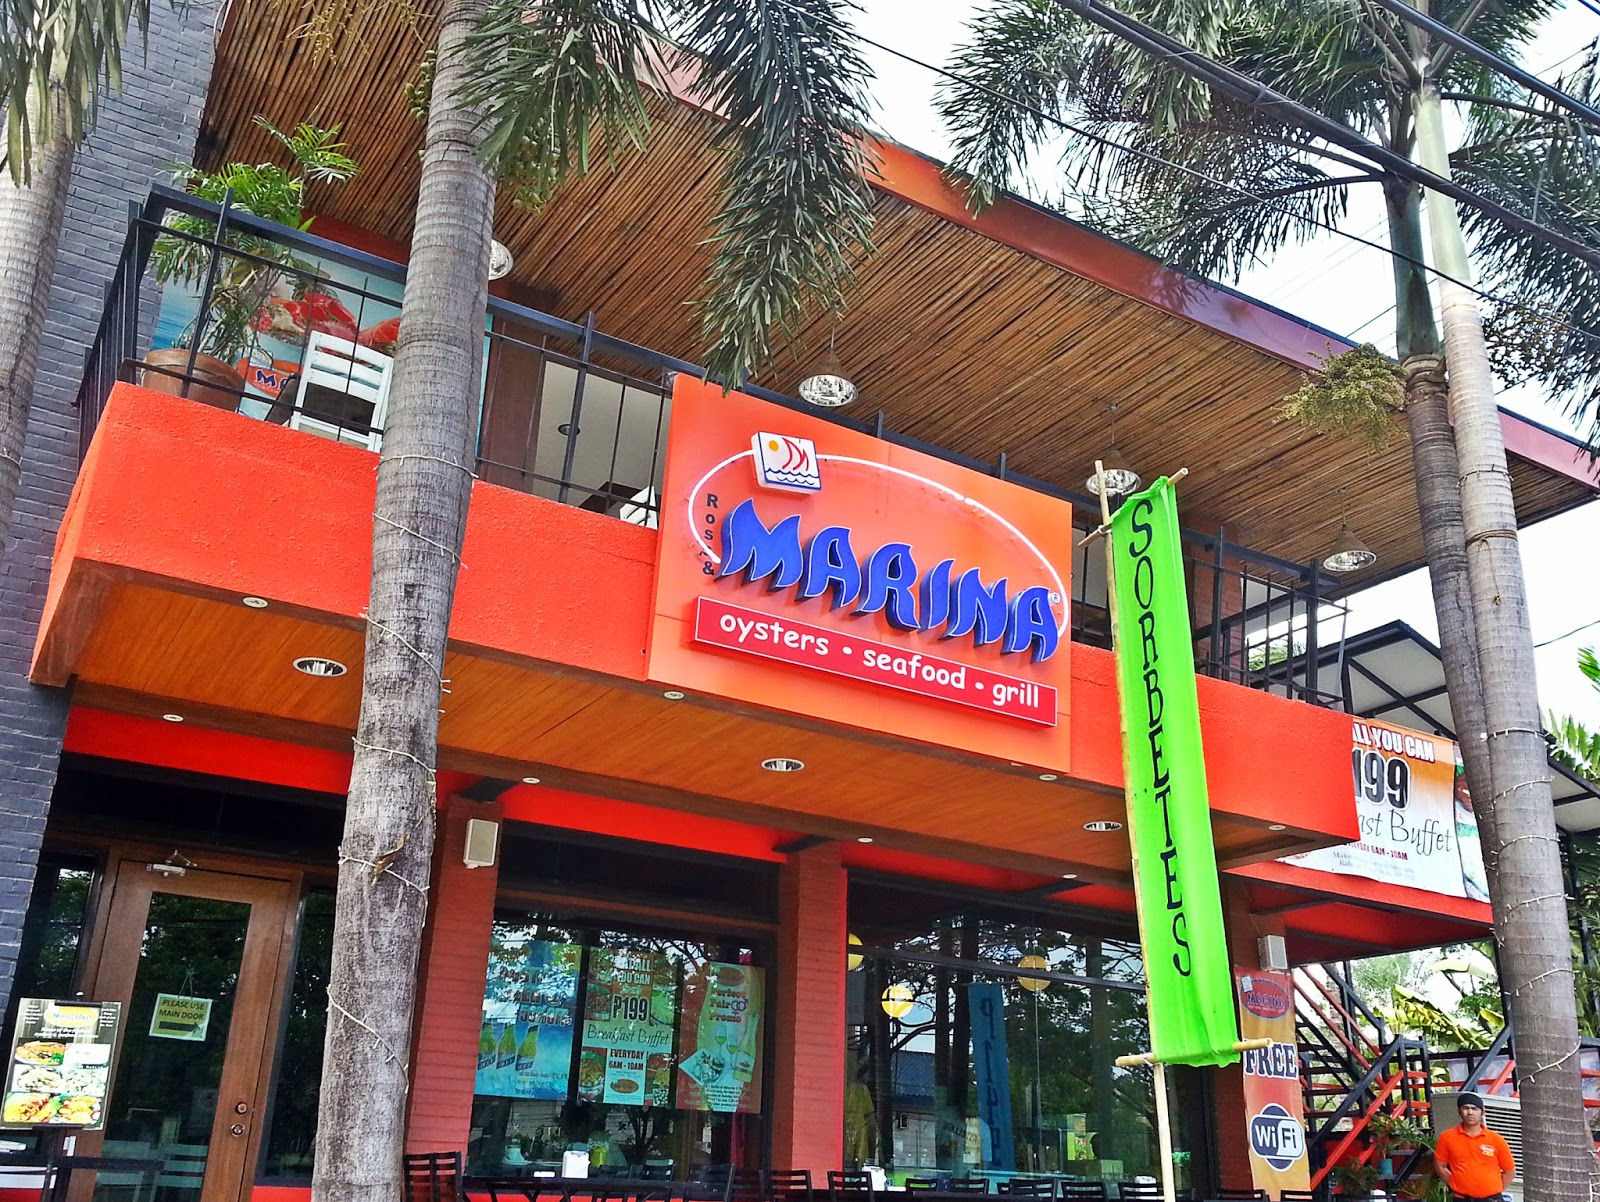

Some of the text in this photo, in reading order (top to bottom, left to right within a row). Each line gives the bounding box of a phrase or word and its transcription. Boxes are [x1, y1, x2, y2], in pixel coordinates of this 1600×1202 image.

[714, 498, 1059, 663] MARINA
[720, 613, 1039, 708] oysters seafood grill
[1129, 498, 1191, 977] SORBETES
[1371, 726, 1403, 755] YOU
[1405, 735, 1435, 763] CAN
[1389, 808, 1453, 856] Buffet
[634, 972, 651, 985] CAN
[159, 1009, 204, 1020] MAIN DOOR
[162, 999, 205, 1011] PLEASE USE
[587, 1023, 670, 1048] Breakfast Buffet
[609, 1060, 623, 1070] 6AM
[627, 1062, 644, 1071] 10AM
[610, 1048, 645, 1060] EVERYDAY
[1244, 1041, 1298, 1079] FREE
[1254, 1125, 1298, 1149] WiFi
